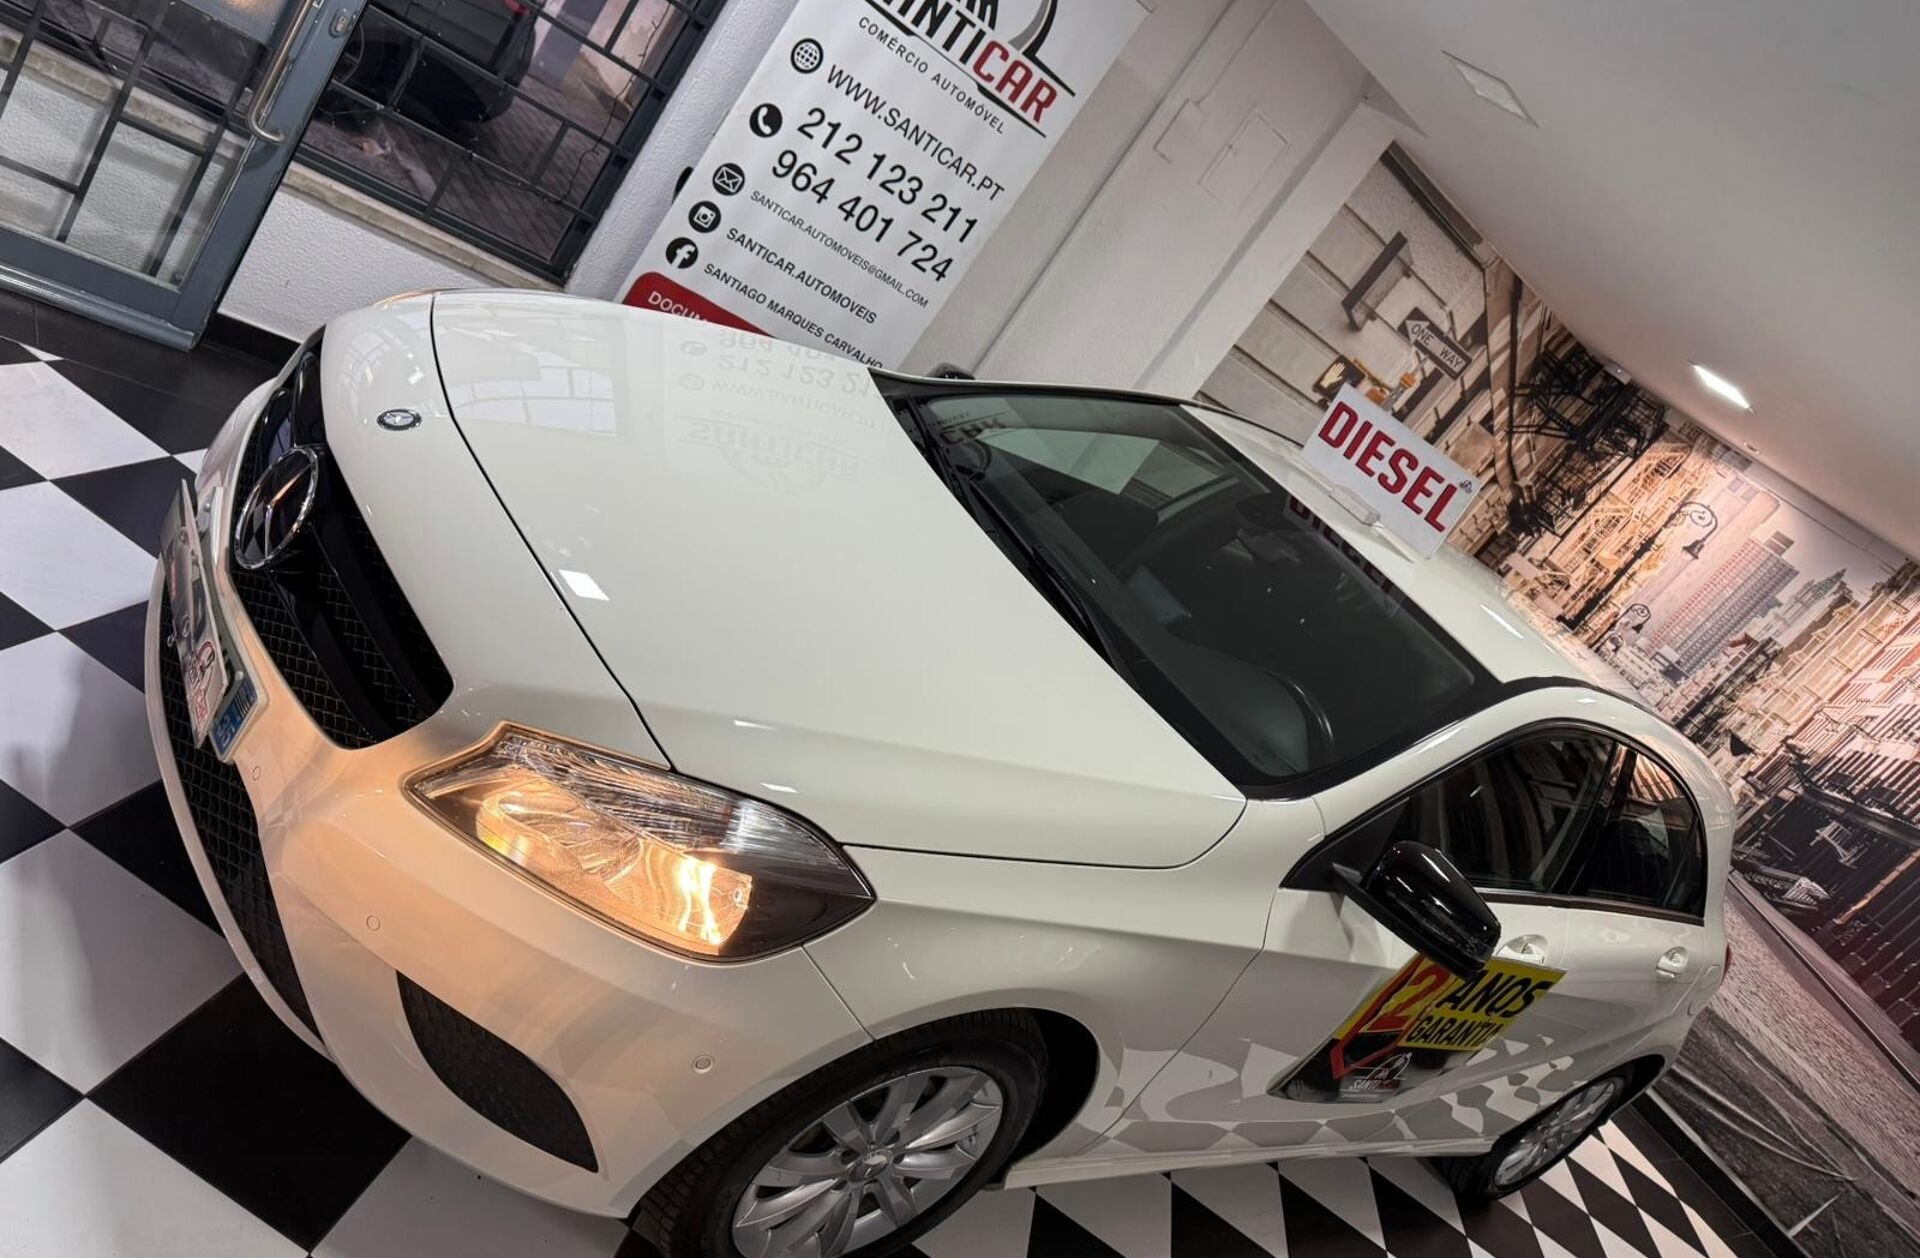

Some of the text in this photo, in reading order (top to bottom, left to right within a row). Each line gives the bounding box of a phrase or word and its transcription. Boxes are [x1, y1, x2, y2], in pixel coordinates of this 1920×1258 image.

[827, 64, 1005, 201] WWW.SANTICAR.PT
[858, 16, 1005, 135] COMÉRCIO AUTOMÓVEL
[771, 149, 954, 282] 964 401 724
[796, 107, 978, 244] 212 123 211
[703, 263, 768, 305] SANTIAGO
[766, 299, 825, 338] MARQUES
[726, 227, 877, 324] SANTICAR.AUTOMOVEIS
[750, 190, 929, 309] SANTICAR.AUTOMOVEIS@GMAIL.COM
[1411, 324, 1465, 369] ONE WAY
[1318, 401, 1458, 533] DIESEL
